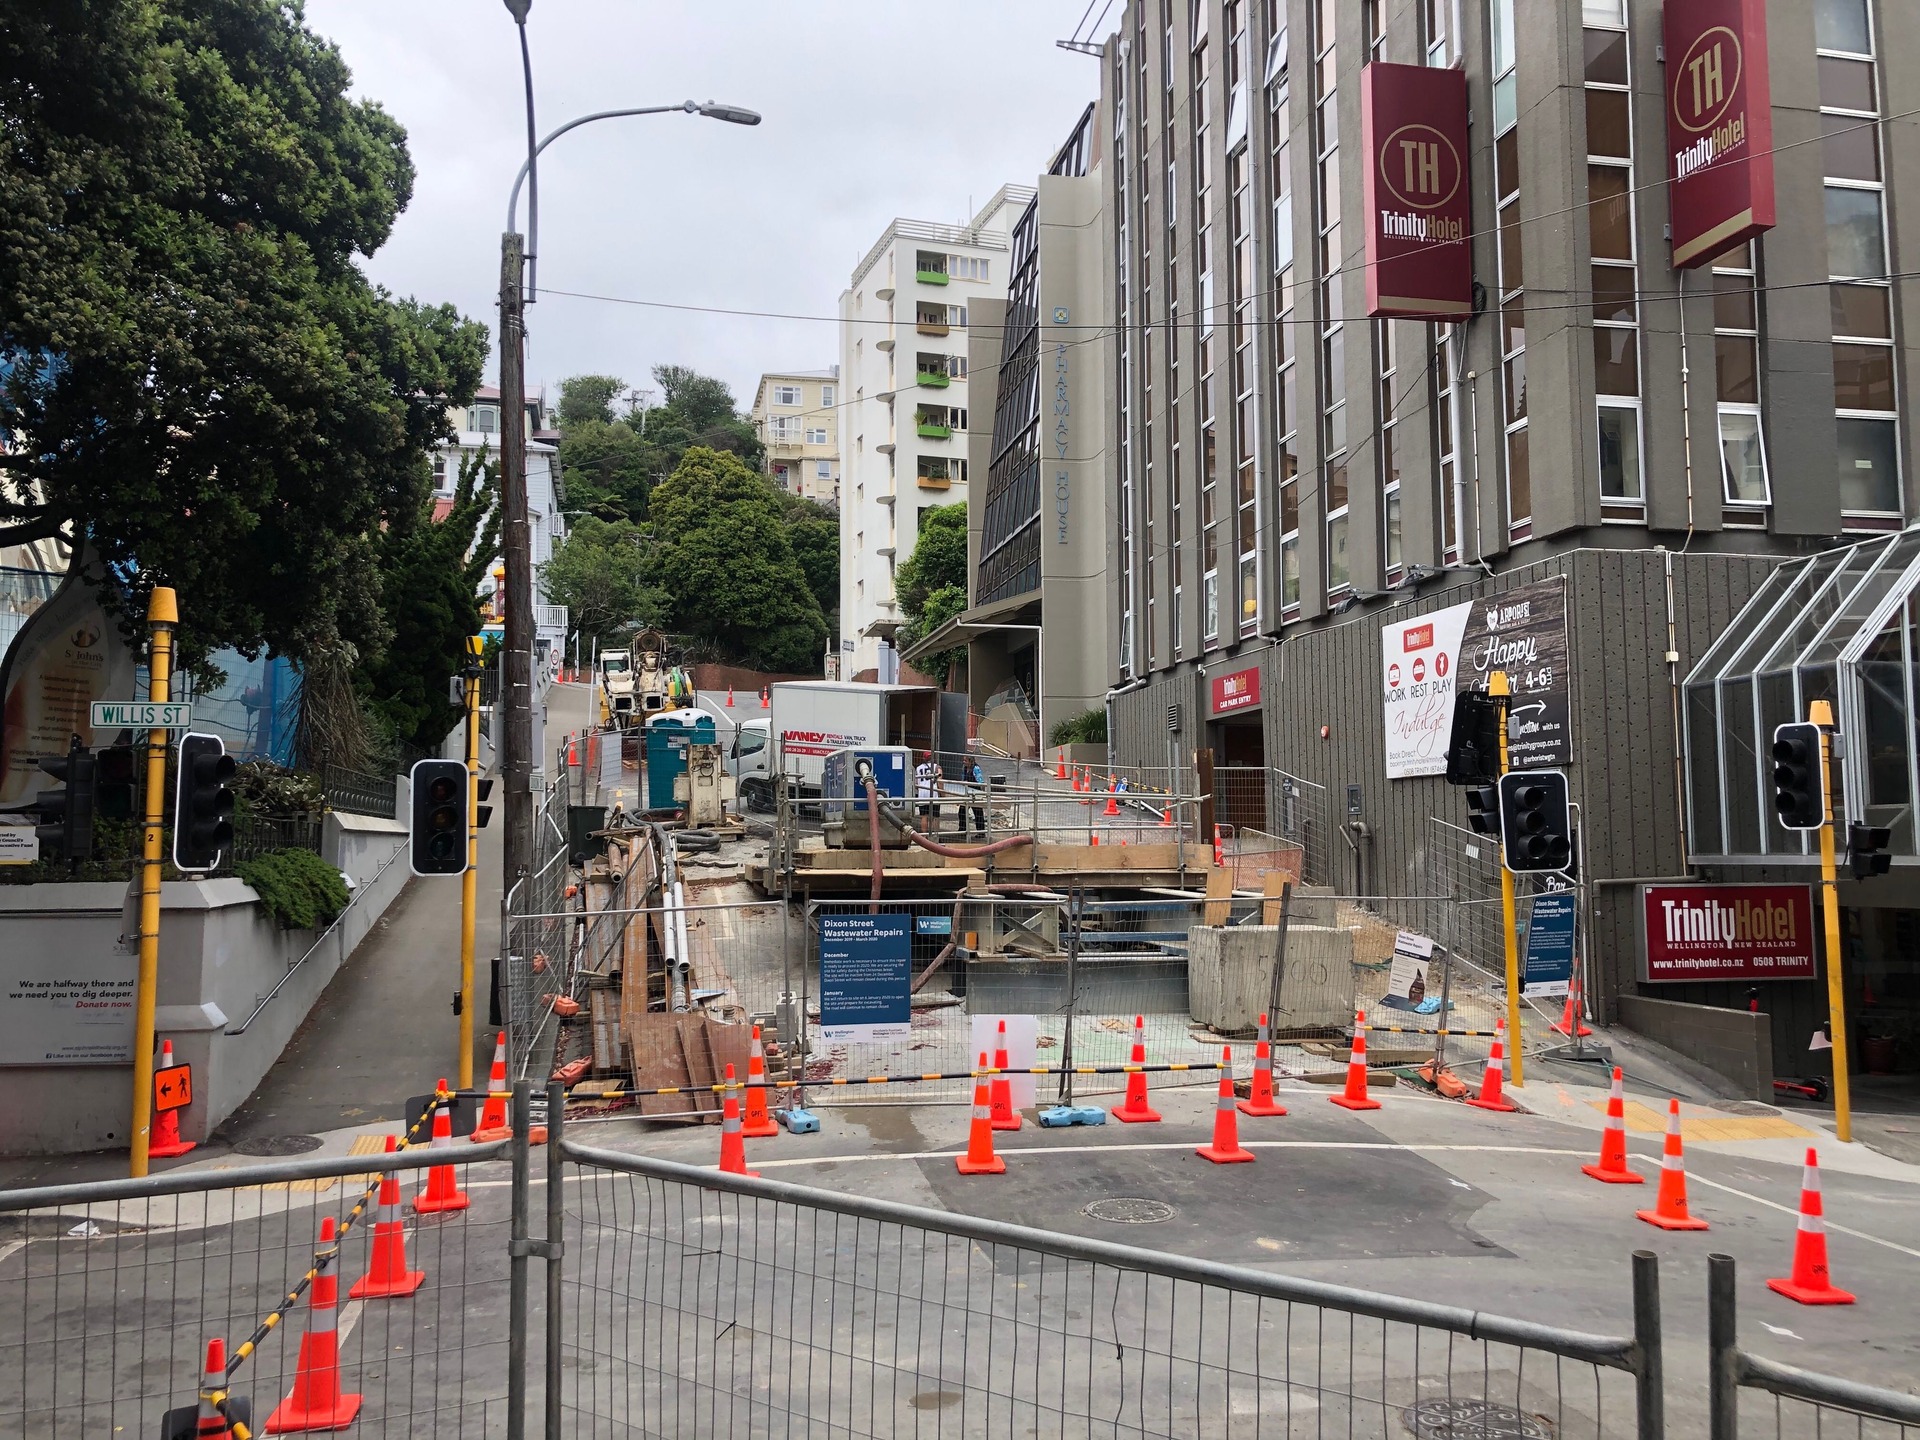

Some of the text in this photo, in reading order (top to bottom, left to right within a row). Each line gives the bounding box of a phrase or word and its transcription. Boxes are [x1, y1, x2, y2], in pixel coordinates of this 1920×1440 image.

[1689, 42, 1723, 117] TH
[1675, 112, 1744, 178] TrinityHotel
[1400, 140, 1439, 194] TH
[1381, 210, 1462, 242] TrinityHotel
[1054, 344, 1069, 544] PHARMACY HOUSE
[1473, 636, 1538, 671] Happy
[1385, 678, 1452, 703] WORK REST PLAY
[1470, 671, 1519, 693] Hr
[1526, 668, 1547, 688] 4-6
[1228, 698, 1238, 706] PARK
[1239, 695, 1251, 704] ENTRY
[102, 707, 182, 724] WILLIS ST
[1393, 691, 1447, 757] Indulge
[1542, 722, 1553, 730] with
[1390, 750, 1416, 760] Book Direct
[148, 834, 154, 843] 2
[873, 928, 904, 937] Repairs
[1662, 899, 1796, 949] TrinityHotel
[1653, 956, 1809, 970] www.trinityhotel.co.nz 0508 TRINITY
[51, 992, 67, 1000] you
[82, 990, 96, 1000] dig
[99, 990, 132, 999] deeper.
[53, 980, 88, 989] halfway
